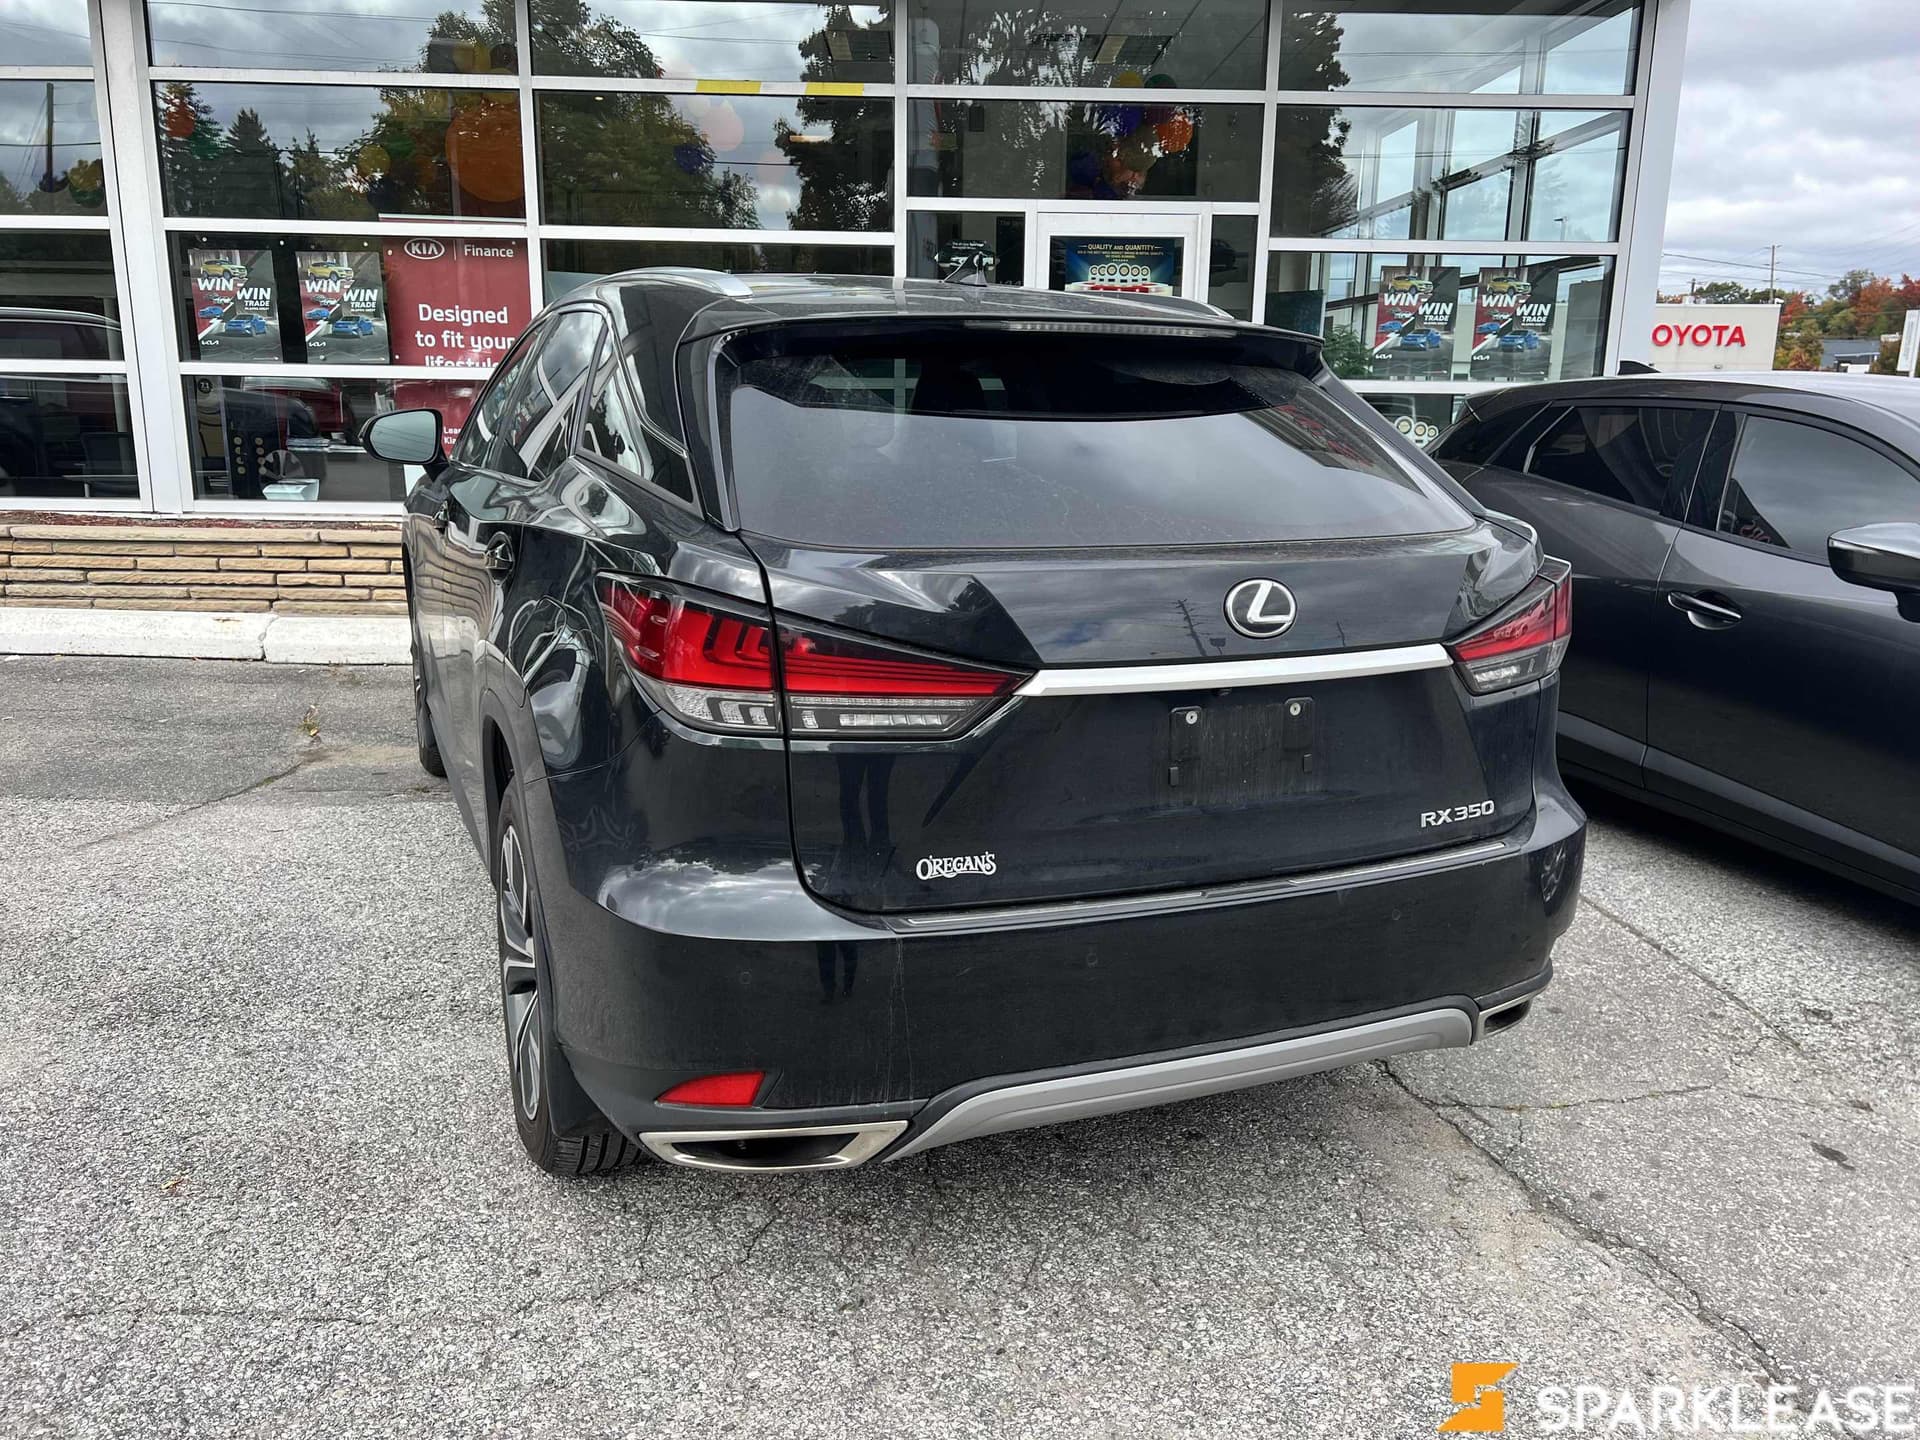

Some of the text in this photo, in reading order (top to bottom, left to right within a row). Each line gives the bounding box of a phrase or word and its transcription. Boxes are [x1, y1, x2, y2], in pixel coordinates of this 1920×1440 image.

[464, 245, 514, 257] Finance
[236, 288, 271, 300] WIN
[342, 289, 378, 302] WIN
[418, 303, 509, 327] Designed
[1418, 302, 1453, 315] WIN
[1516, 303, 1551, 316] WIN
[415, 330, 515, 352] to fit your
[1651, 324, 1747, 348] OYOTA
